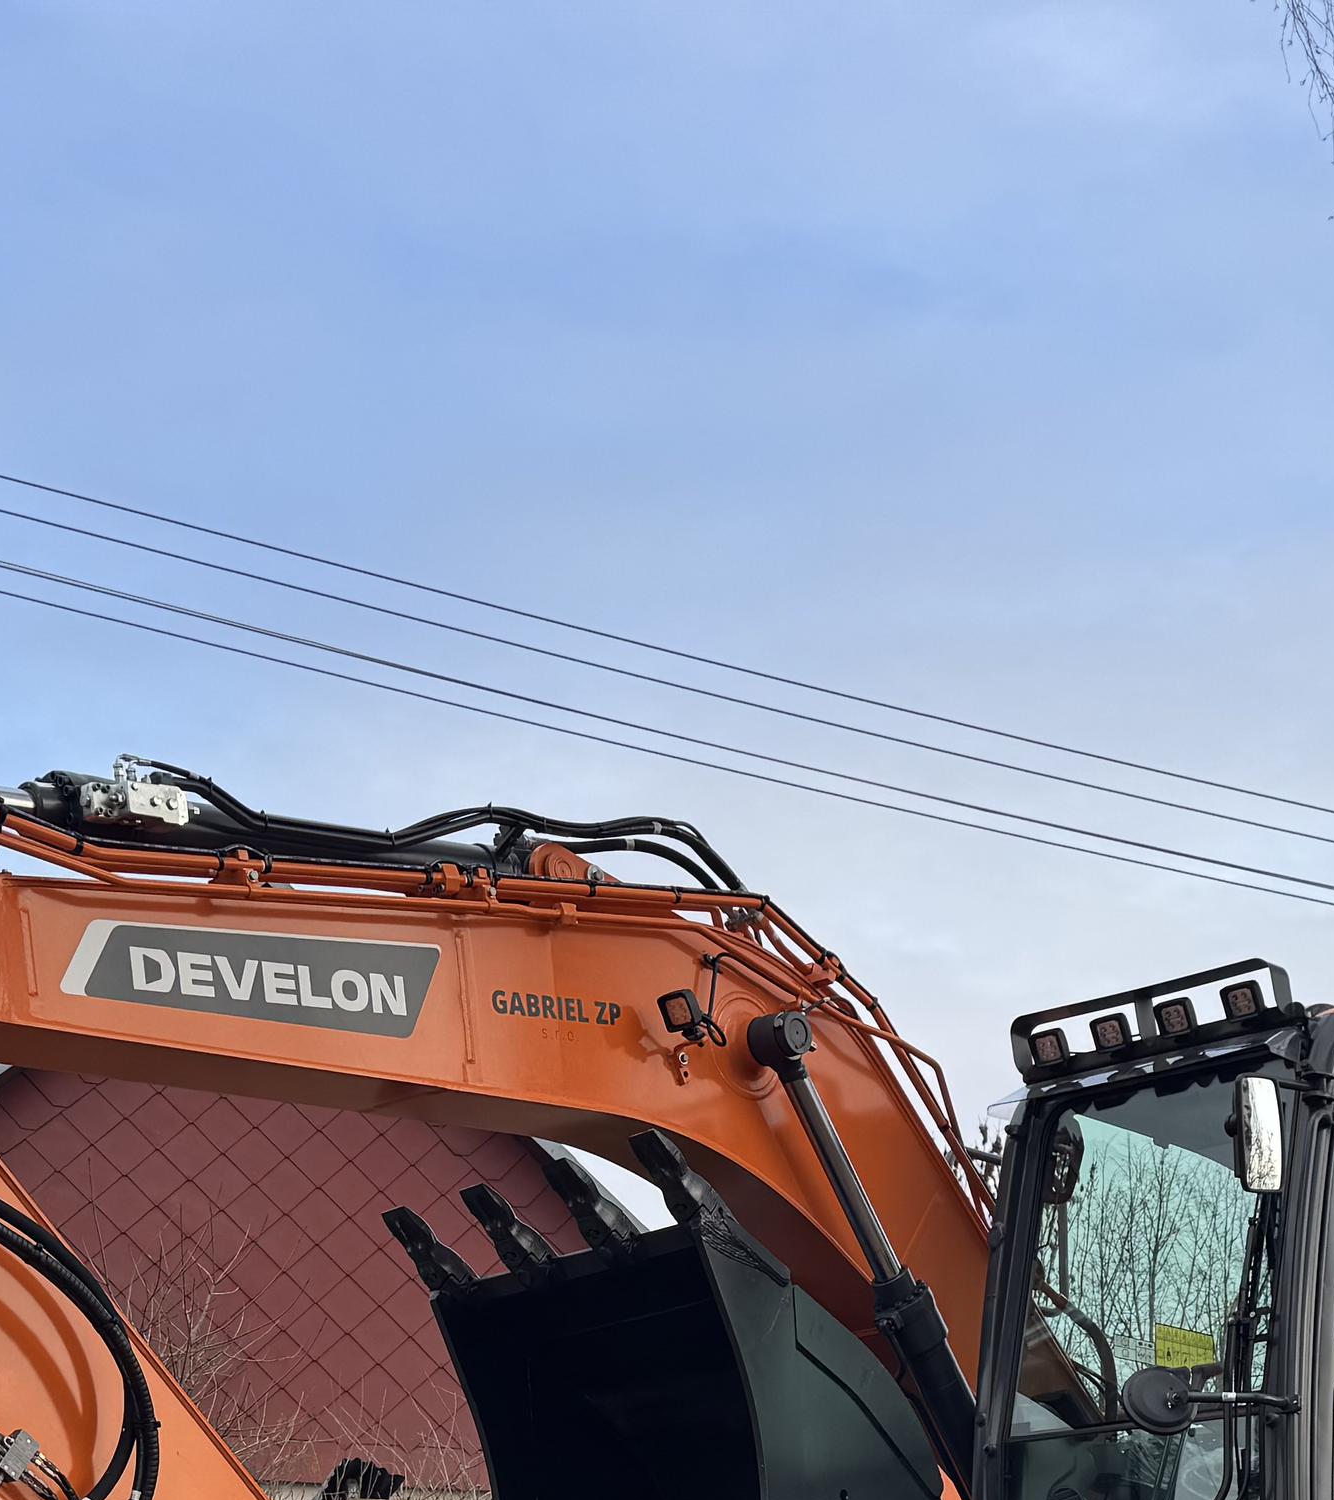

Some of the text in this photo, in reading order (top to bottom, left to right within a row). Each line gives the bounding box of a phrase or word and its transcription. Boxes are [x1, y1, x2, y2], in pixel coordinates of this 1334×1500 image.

[128, 945, 408, 1017] DEVELON
[491, 989, 622, 1026] GABRIEL ZP
[541, 1027, 580, 1042] s.r.o.
